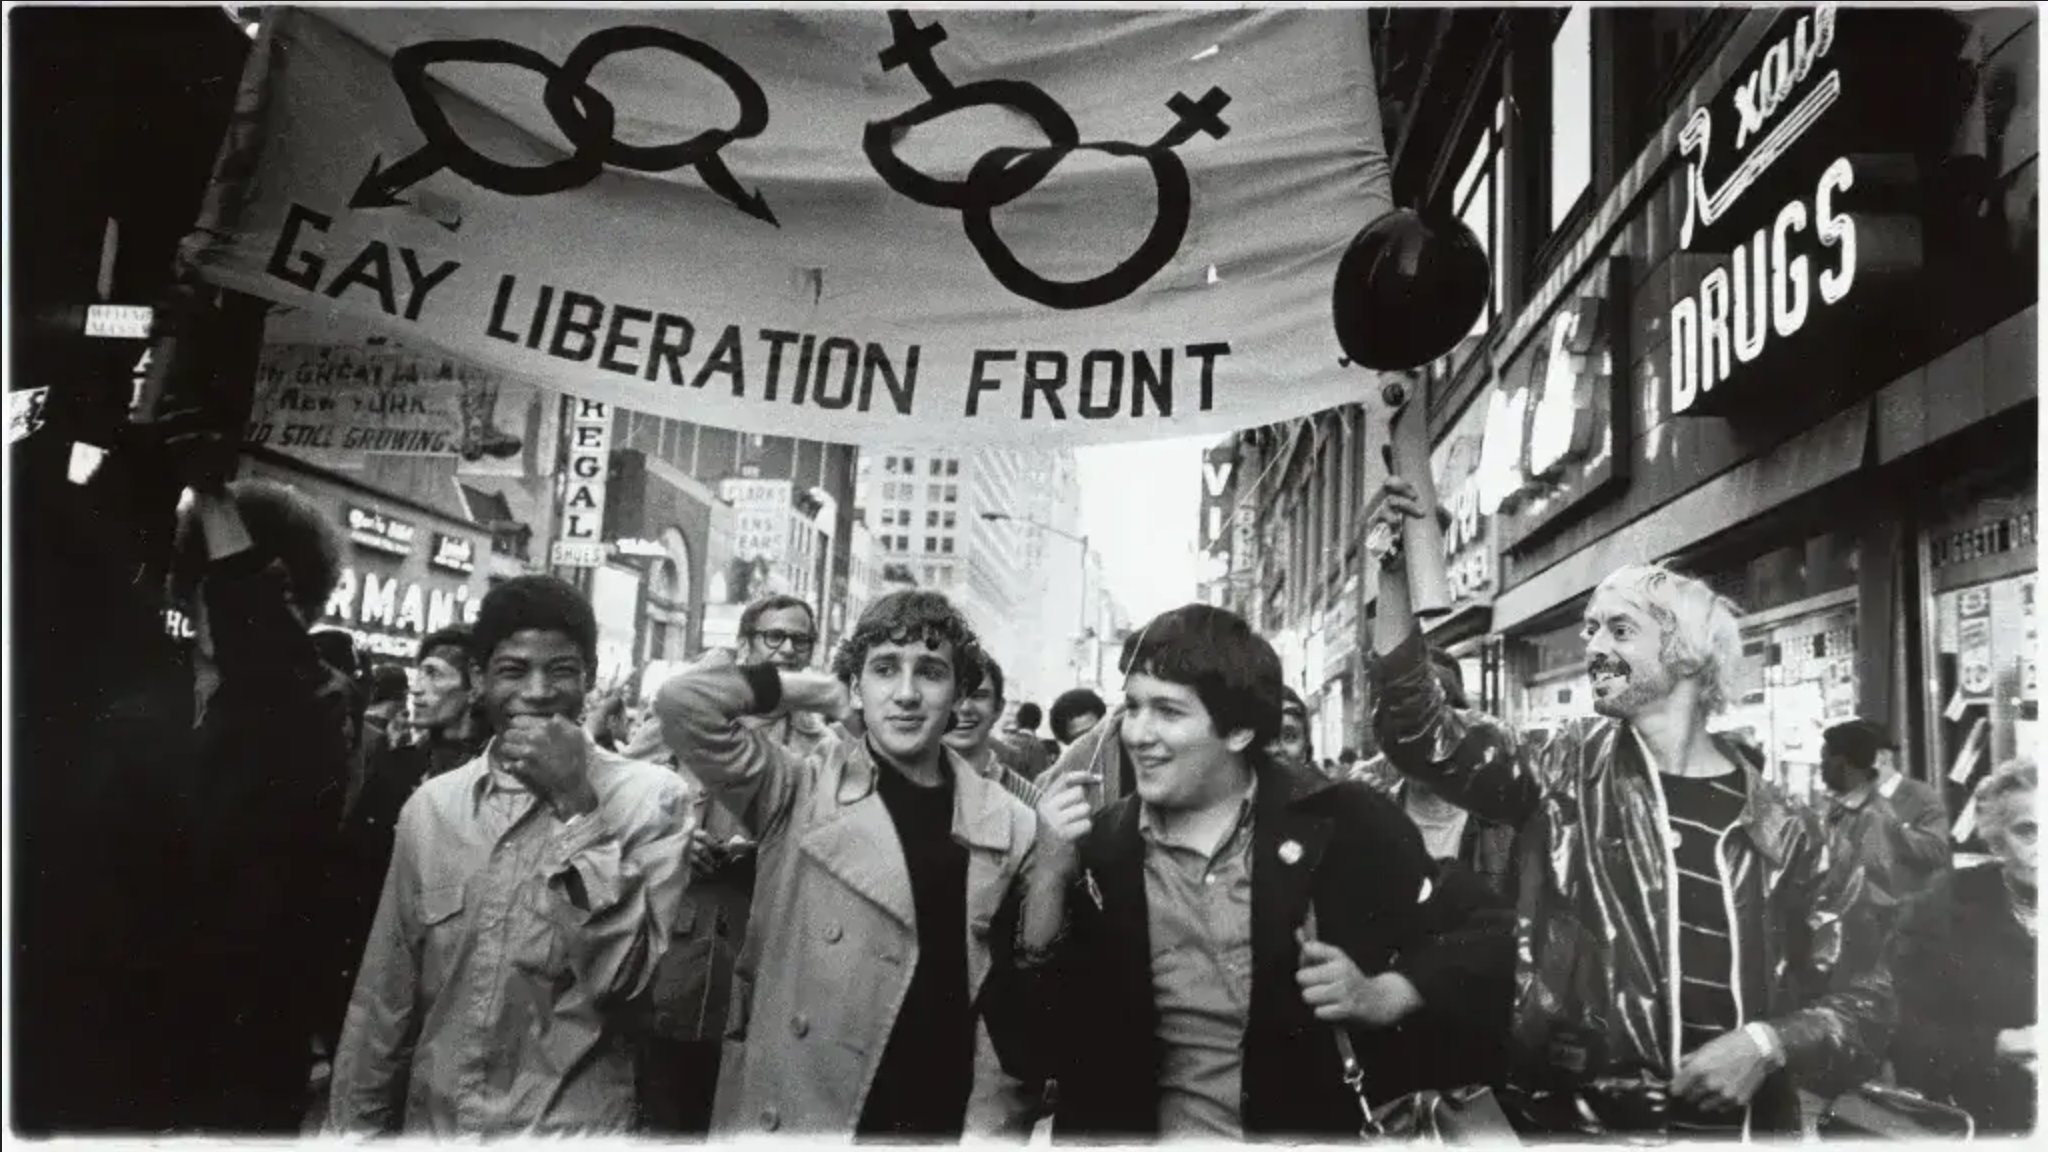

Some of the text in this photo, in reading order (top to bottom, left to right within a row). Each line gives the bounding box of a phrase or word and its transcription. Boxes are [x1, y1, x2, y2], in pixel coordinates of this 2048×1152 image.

[1678, 4, 1840, 250] Rxall
[265, 202, 1231, 420] GAY LIBERATION FRONT
[1671, 156, 1857, 414] DRUGS
[279, 422, 334, 448] STILL
[342, 425, 451, 453] GROWING
[553, 545, 602, 562] SHOES
